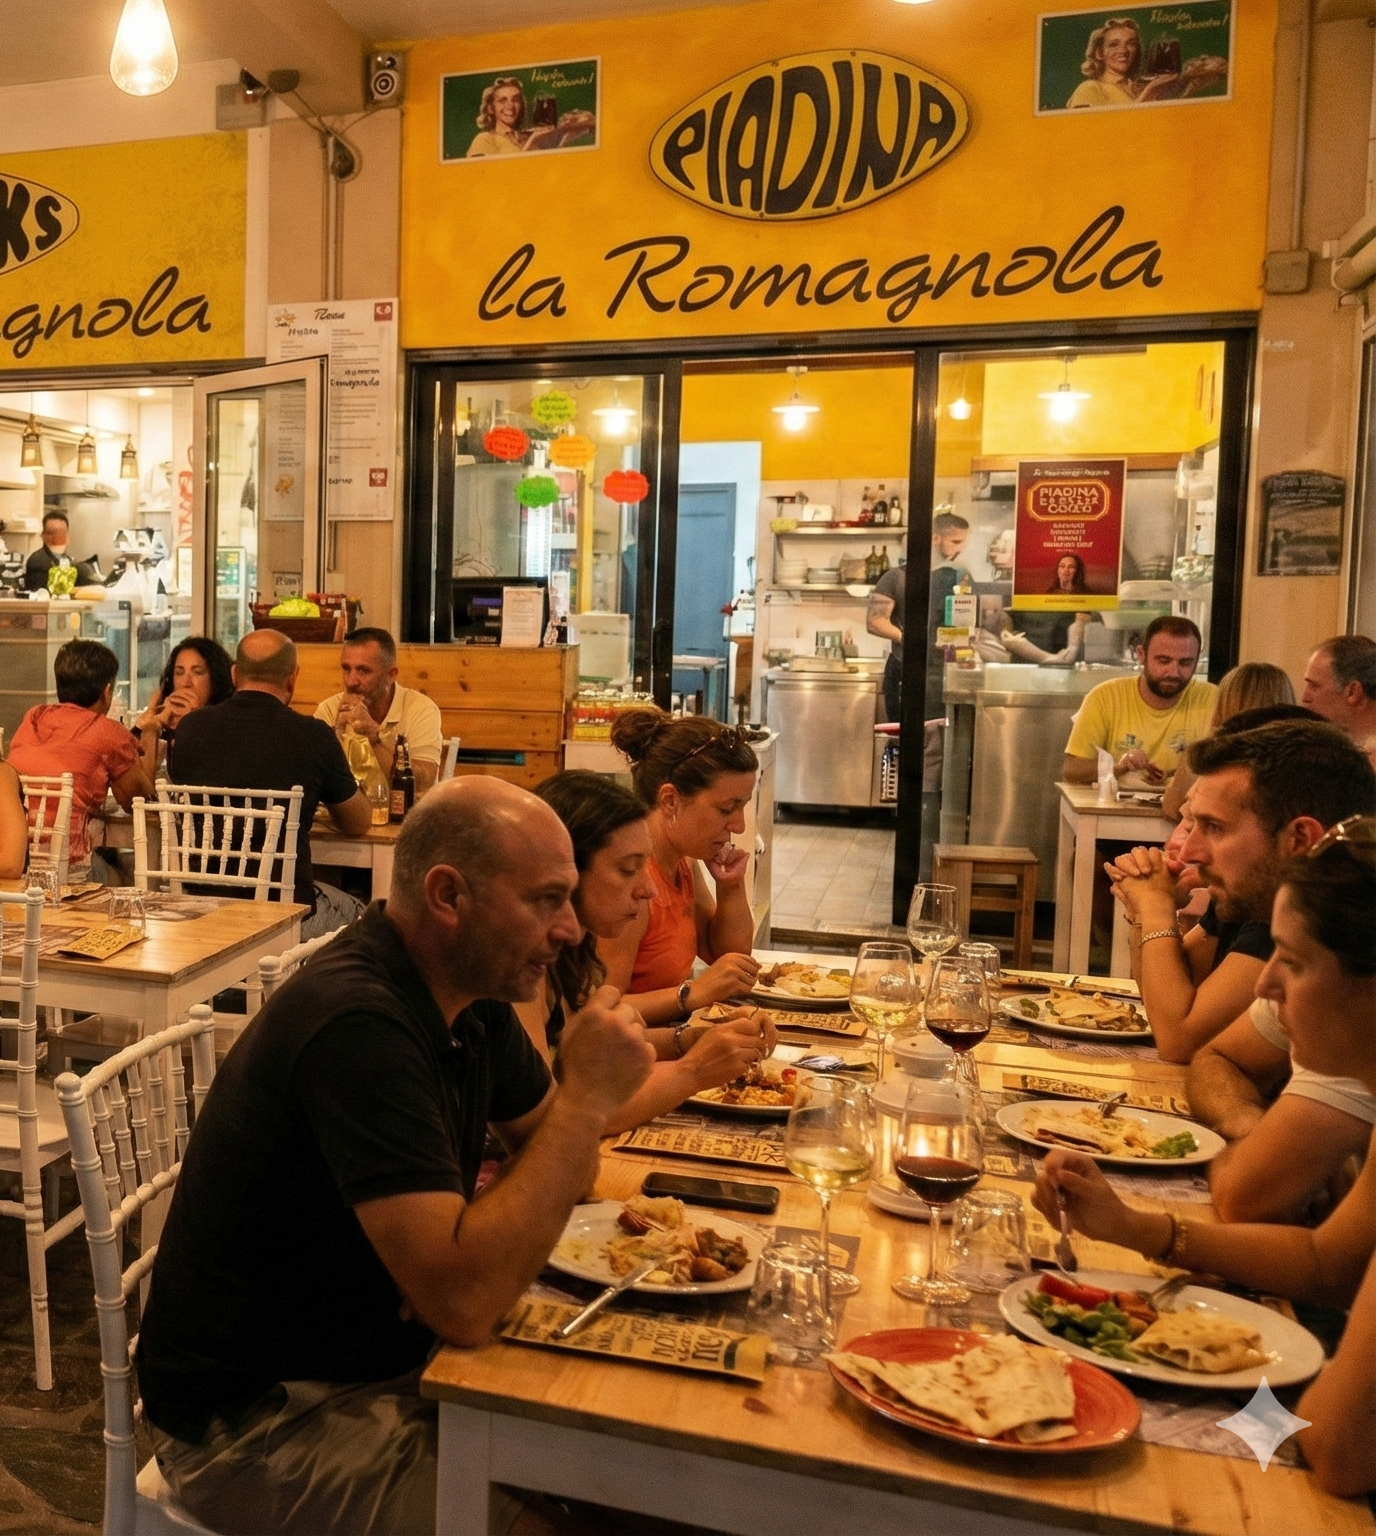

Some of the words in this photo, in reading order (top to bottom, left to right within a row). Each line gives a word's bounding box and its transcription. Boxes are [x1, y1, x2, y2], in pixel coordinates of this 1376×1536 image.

[662, 61, 958, 214] PIADINA
[478, 244, 567, 320] la
[605, 206, 1163, 322] Romagnola
